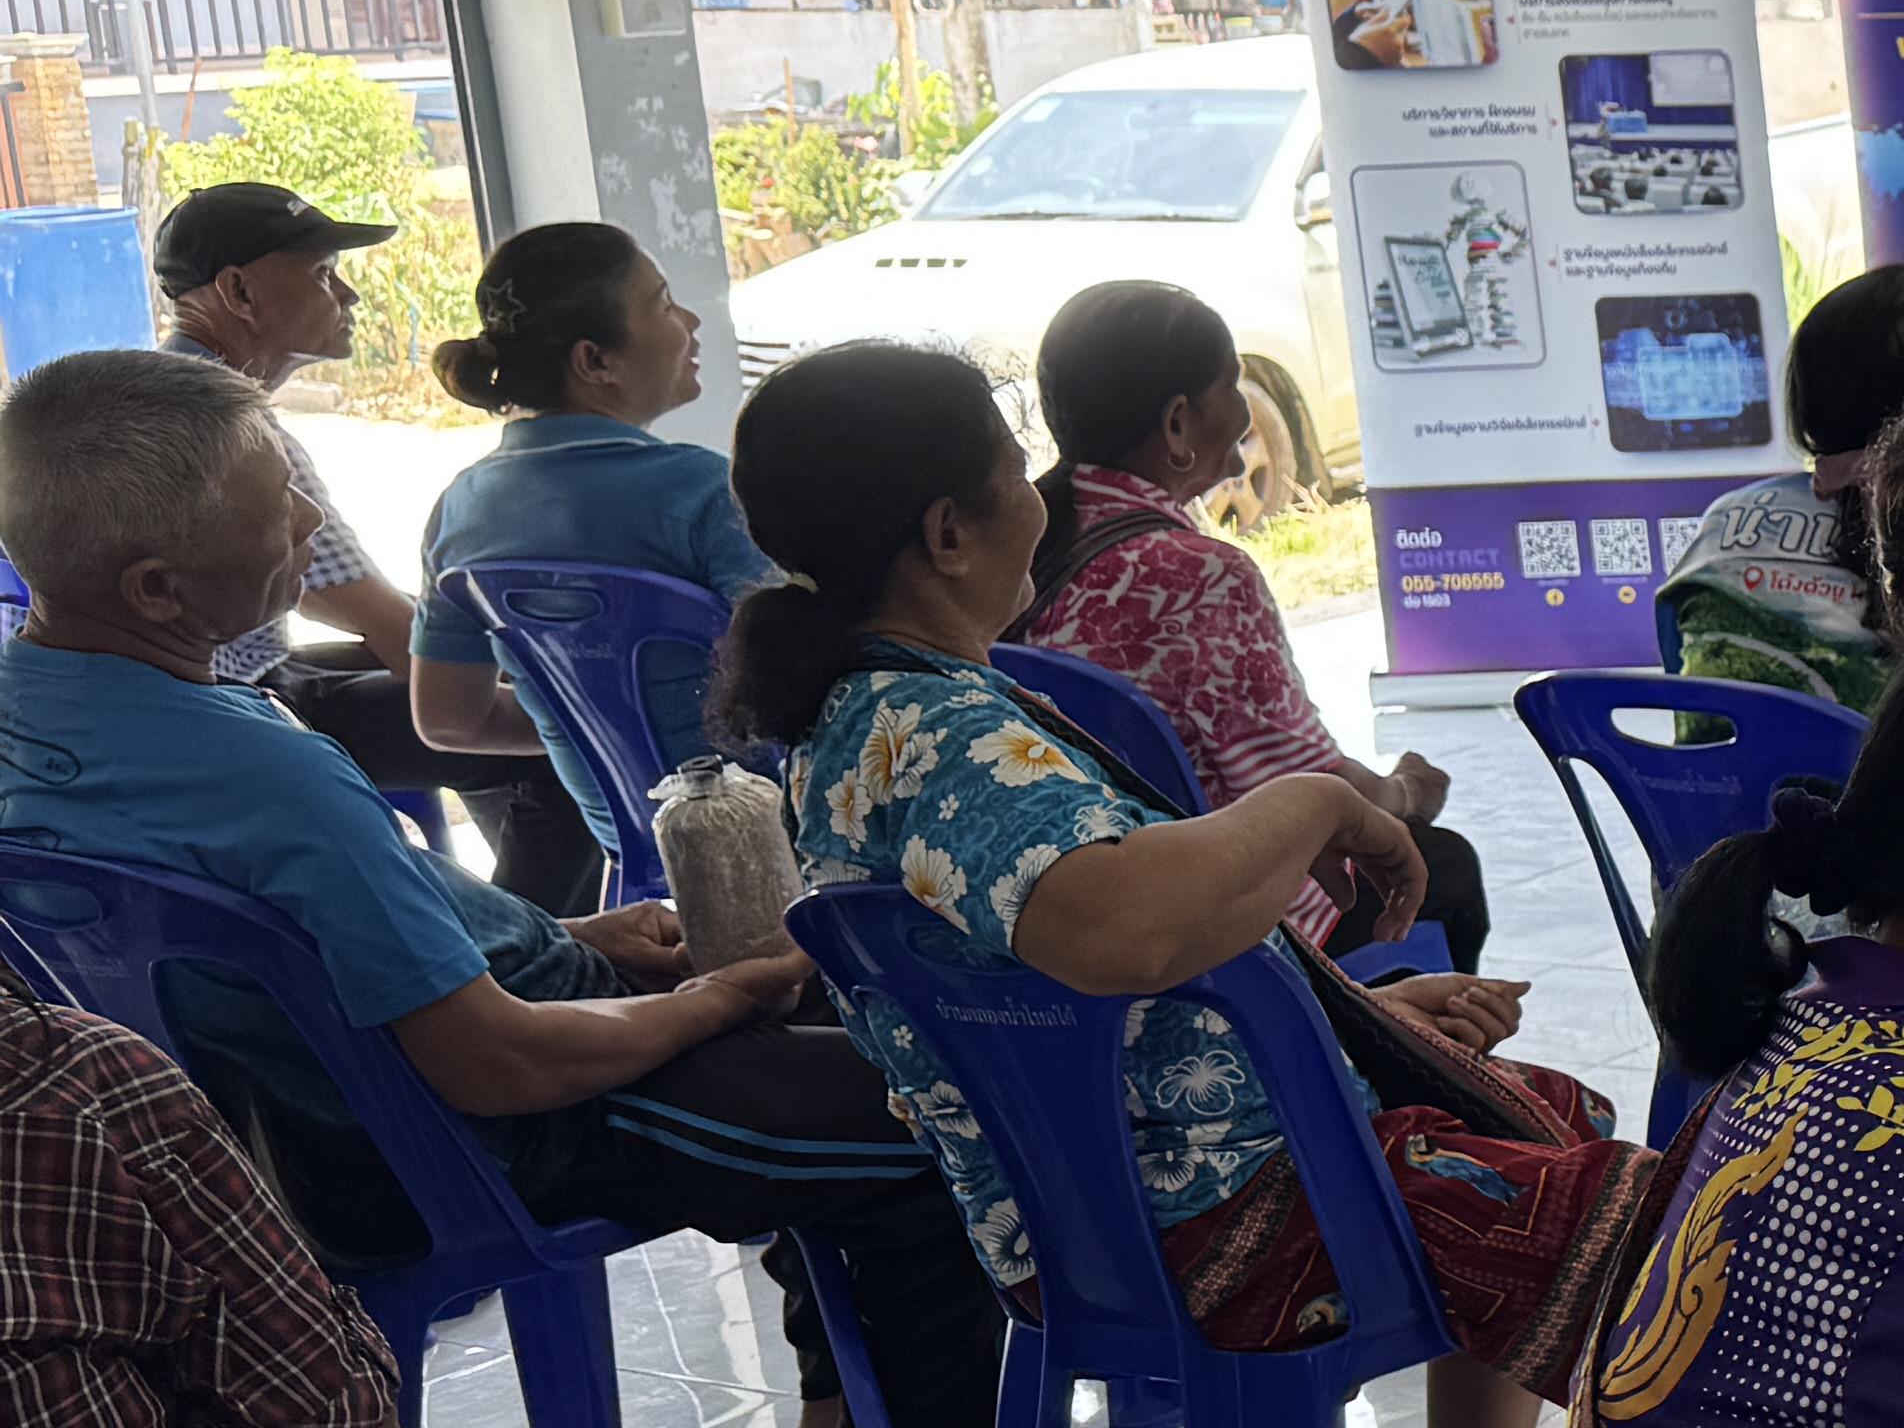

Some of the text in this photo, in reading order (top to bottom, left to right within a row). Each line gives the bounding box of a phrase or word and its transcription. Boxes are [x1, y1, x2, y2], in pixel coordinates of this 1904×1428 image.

[1395, 527, 1443, 549] ติดต่อ
[1401, 548, 1500, 570] CONTACT
